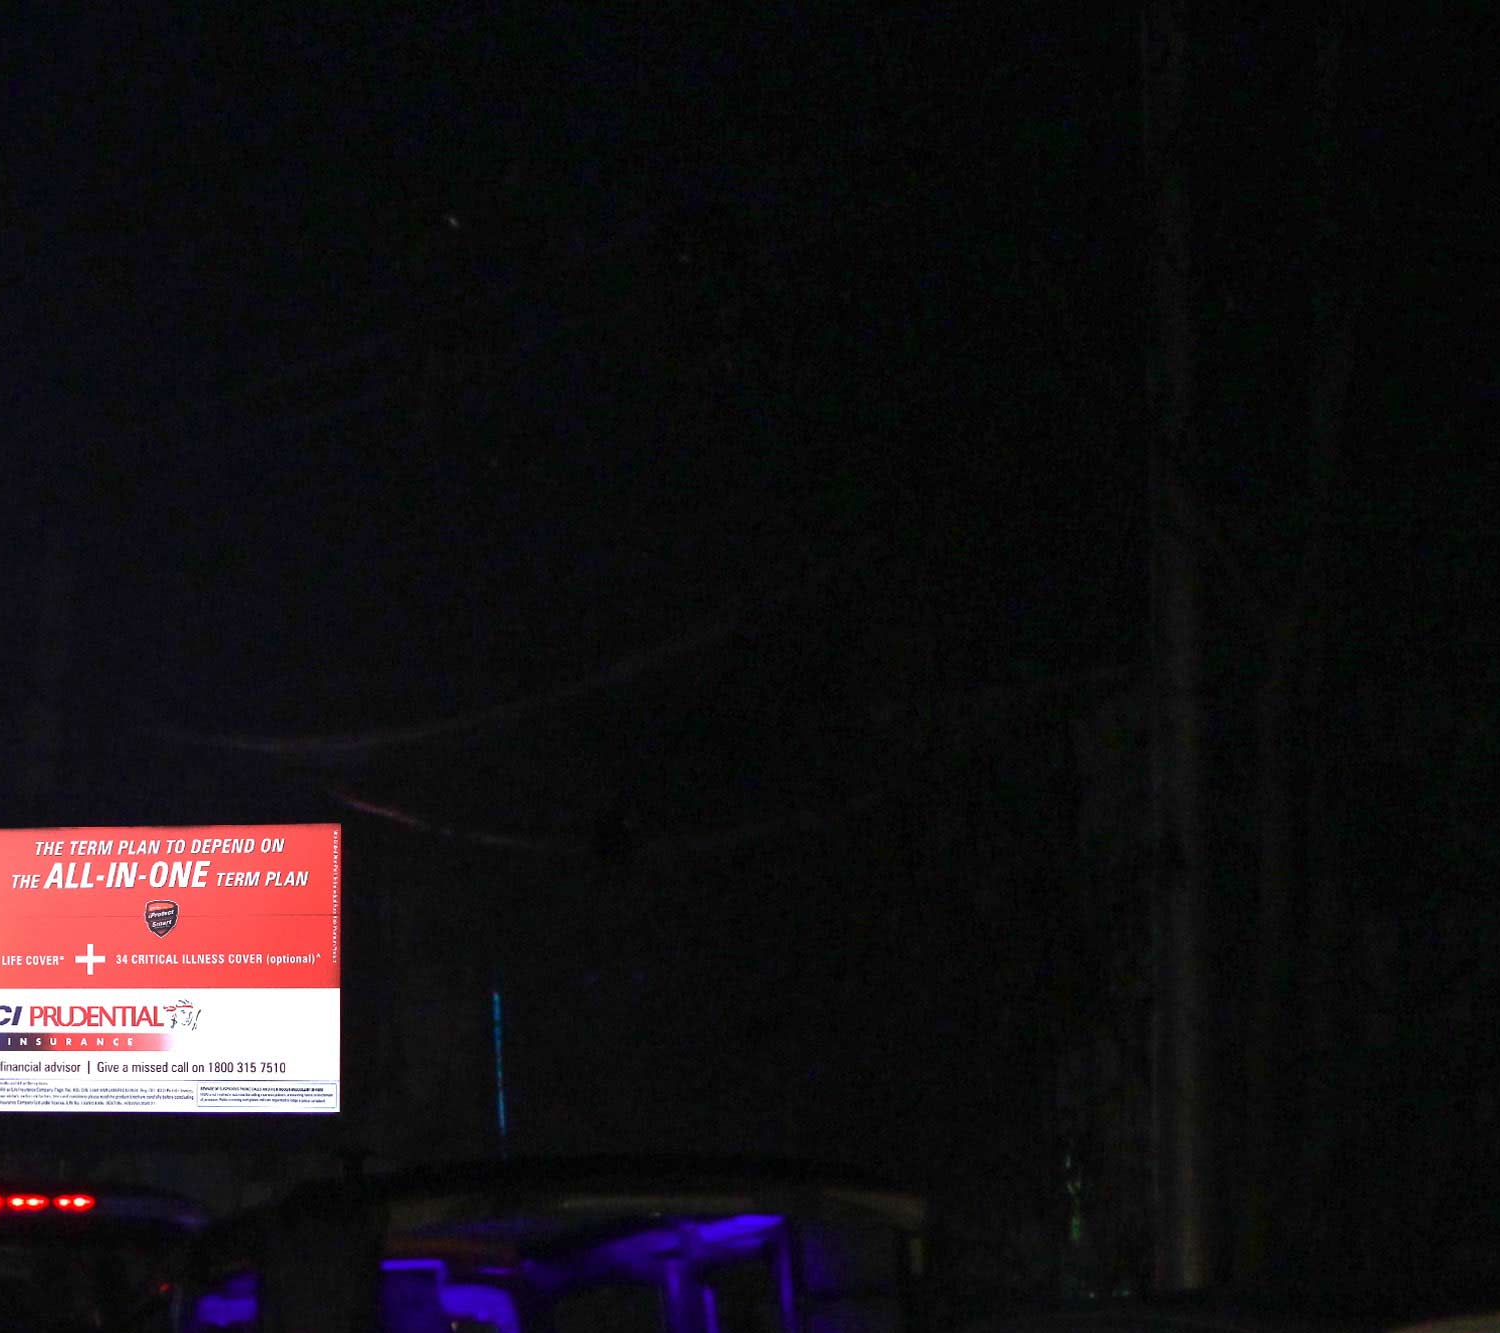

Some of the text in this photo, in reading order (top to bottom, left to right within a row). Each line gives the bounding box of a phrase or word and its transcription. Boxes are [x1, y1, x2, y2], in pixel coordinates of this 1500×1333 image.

[34, 838, 286, 856] THE TERM PLAN TO DEPEND ON
[11, 860, 310, 890] THE ALL-IN-ONE TERM PLAN
[1, 955, 24, 966] LIFE
[115, 954, 129, 965] 34
[131, 954, 179, 965] CRITICAL
[181, 953, 225, 965] ILLNESS
[228, 953, 263, 965] COVER
[30, 1005, 165, 1027] PRUDENTIAL
[7, 1037, 134, 1046] INSURANCE
[0, 1061, 42, 1073] financial
[44, 1061, 81, 1073] advisor
[96, 1061, 120, 1073] Give
[122, 1064, 129, 1073] a
[131, 1061, 169, 1073] missed
[171, 1061, 189, 1073] call
[191, 1064, 205, 1073] on
[208, 1062, 234, 1073] 1800
[236, 1062, 257, 1073] 315
[260, 1062, 286, 1073] 7510
